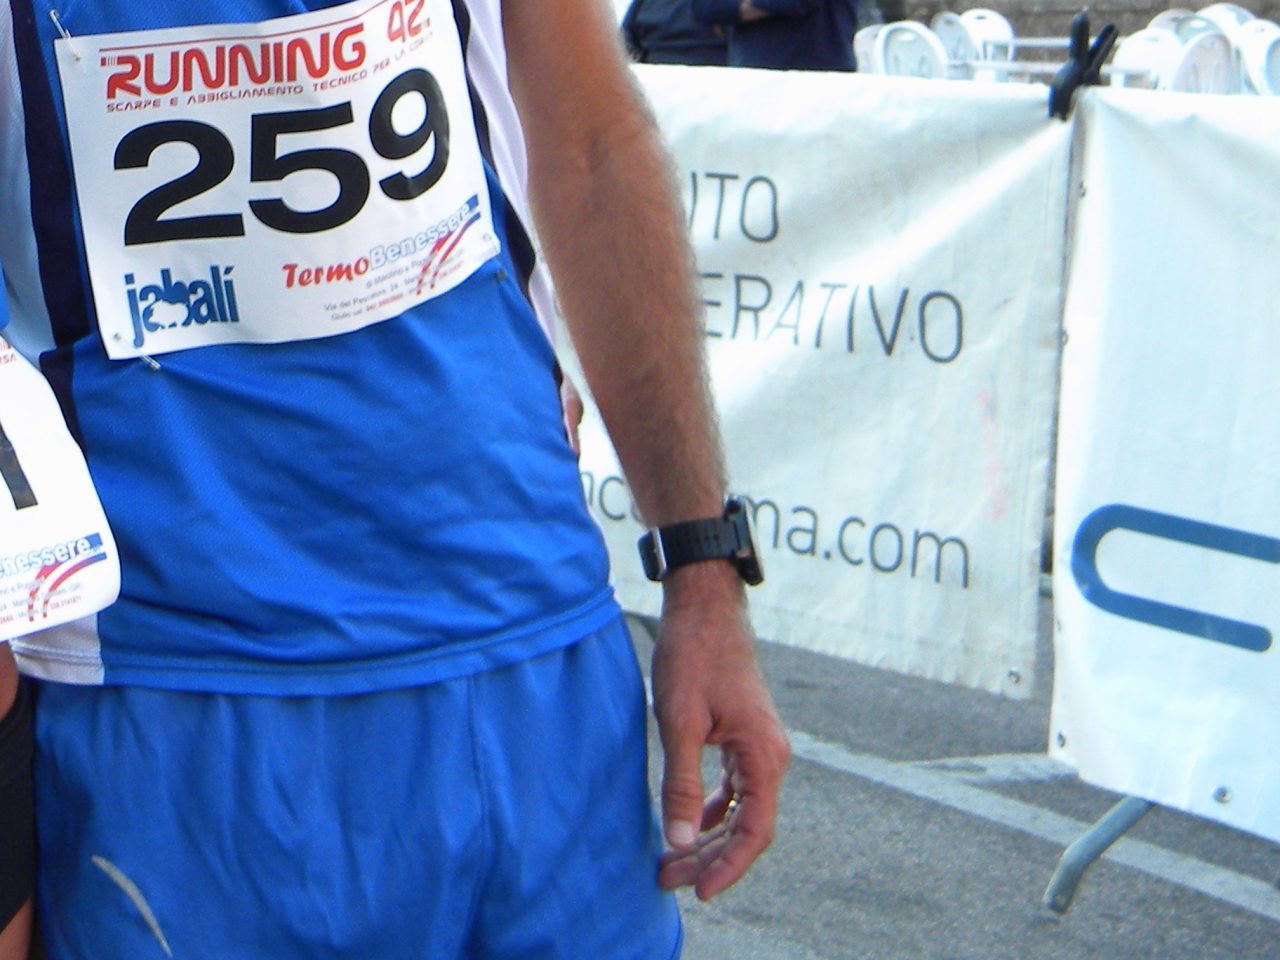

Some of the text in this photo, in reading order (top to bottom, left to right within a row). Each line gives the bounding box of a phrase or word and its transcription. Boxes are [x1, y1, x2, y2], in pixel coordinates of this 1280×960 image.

[101, 23, 367, 99] RUNNING
[107, 98, 160, 113] SCARPE
[170, 97, 178, 107] E
[187, 84, 304, 106] ABBIGLIAMENTO
[313, 70, 368, 90] TECNICO
[114, 68, 451, 246] 259
[697, 271, 964, 364] ERATIVO
